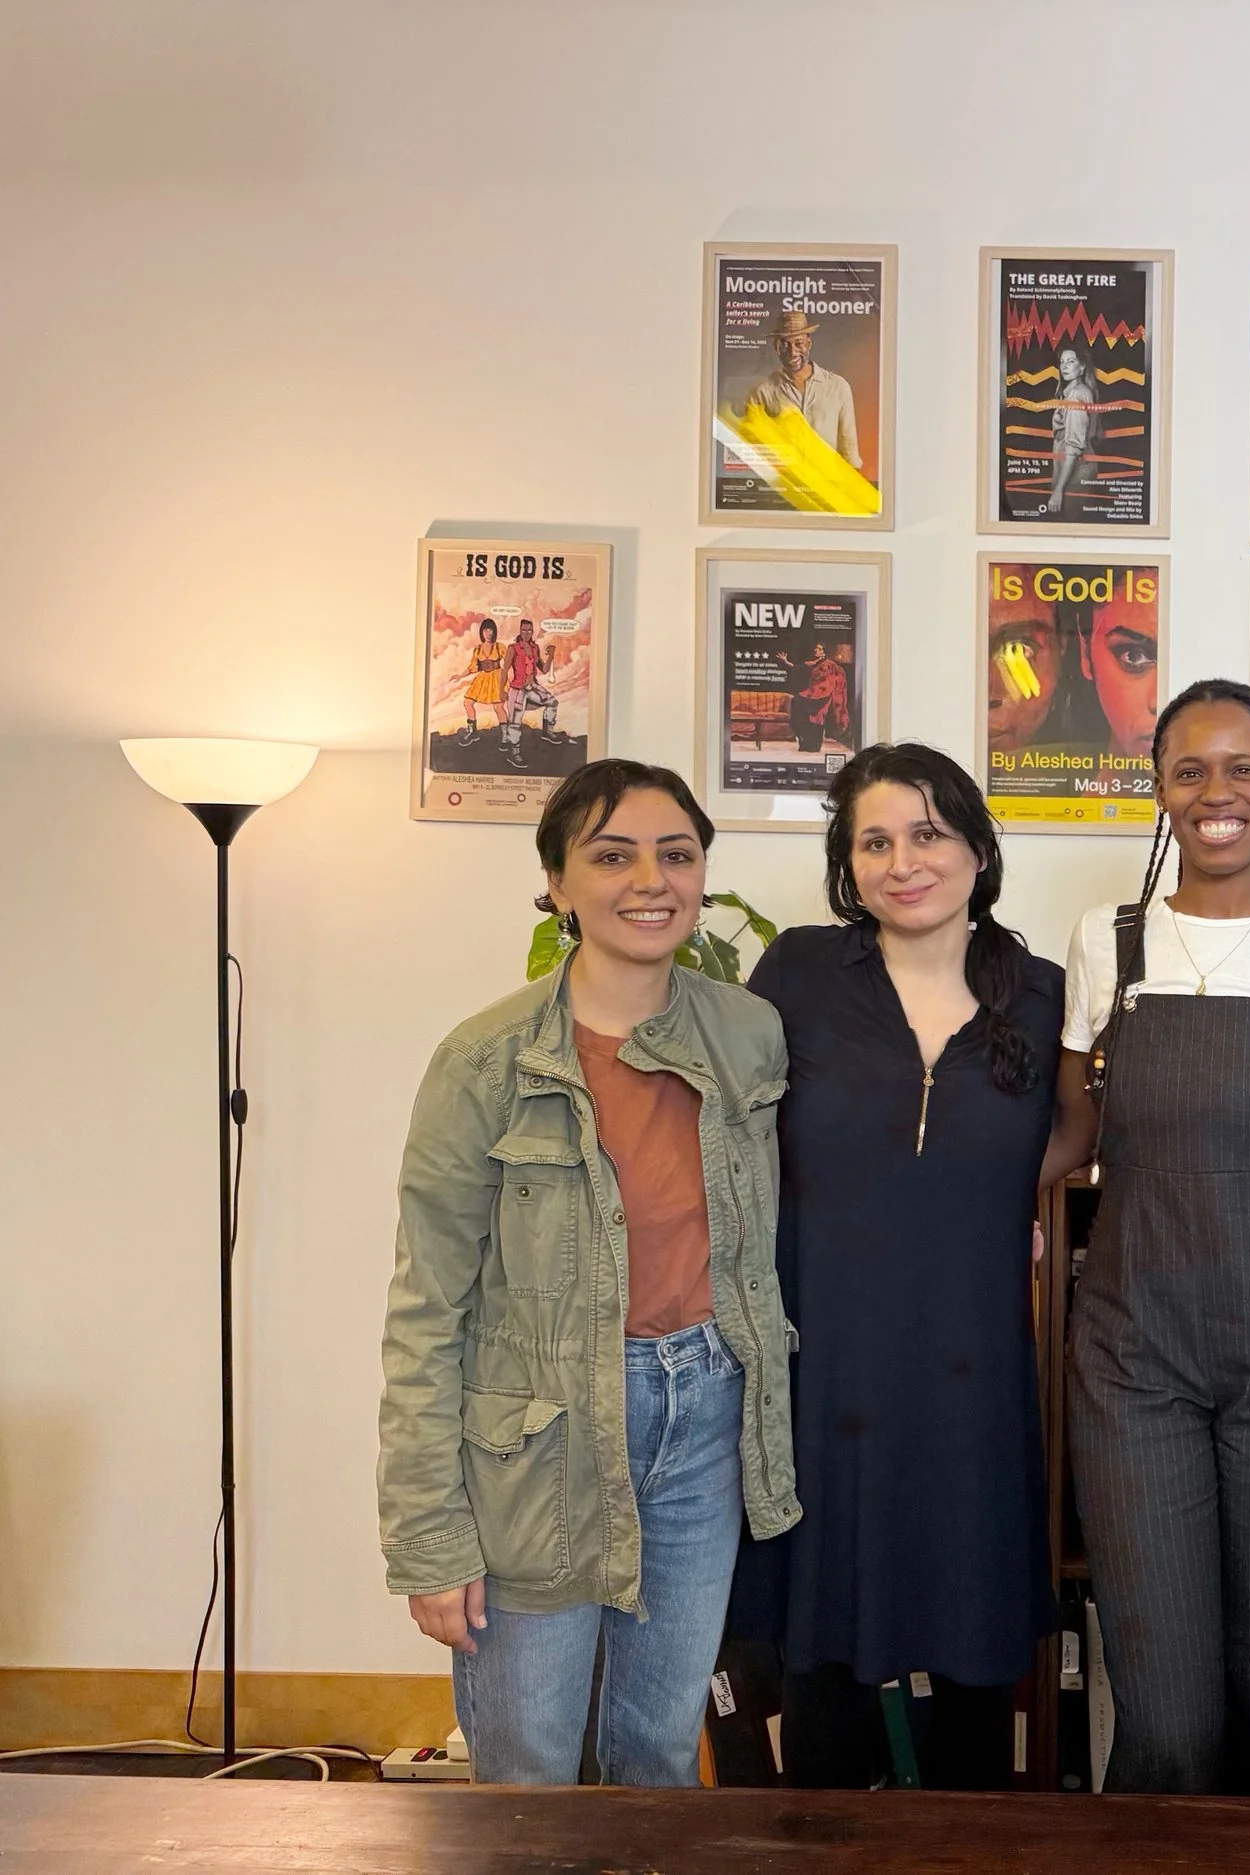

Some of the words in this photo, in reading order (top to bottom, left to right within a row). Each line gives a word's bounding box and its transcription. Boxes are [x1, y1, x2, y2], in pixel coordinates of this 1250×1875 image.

[725, 276, 826, 298] Moonlight
[1009, 273, 1035, 285] THE
[1038, 274, 1083, 286] GREAT
[1086, 274, 1117, 287] FIRE
[782, 296, 874, 315] Schooner
[725, 318, 737, 326] for
[742, 318, 760, 326] living
[466, 554, 488, 577] IS
[494, 555, 537, 579] GOD
[542, 556, 565, 580] IS
[993, 567, 1023, 601] Is
[1033, 567, 1113, 603] God
[1126, 569, 1157, 604] Is
[734, 602, 806, 628] NEW
[991, 751, 1015, 772] By
[1020, 751, 1094, 769] Aleshea
[1099, 753, 1153, 770] Harris
[1074, 778, 1108, 795] May
